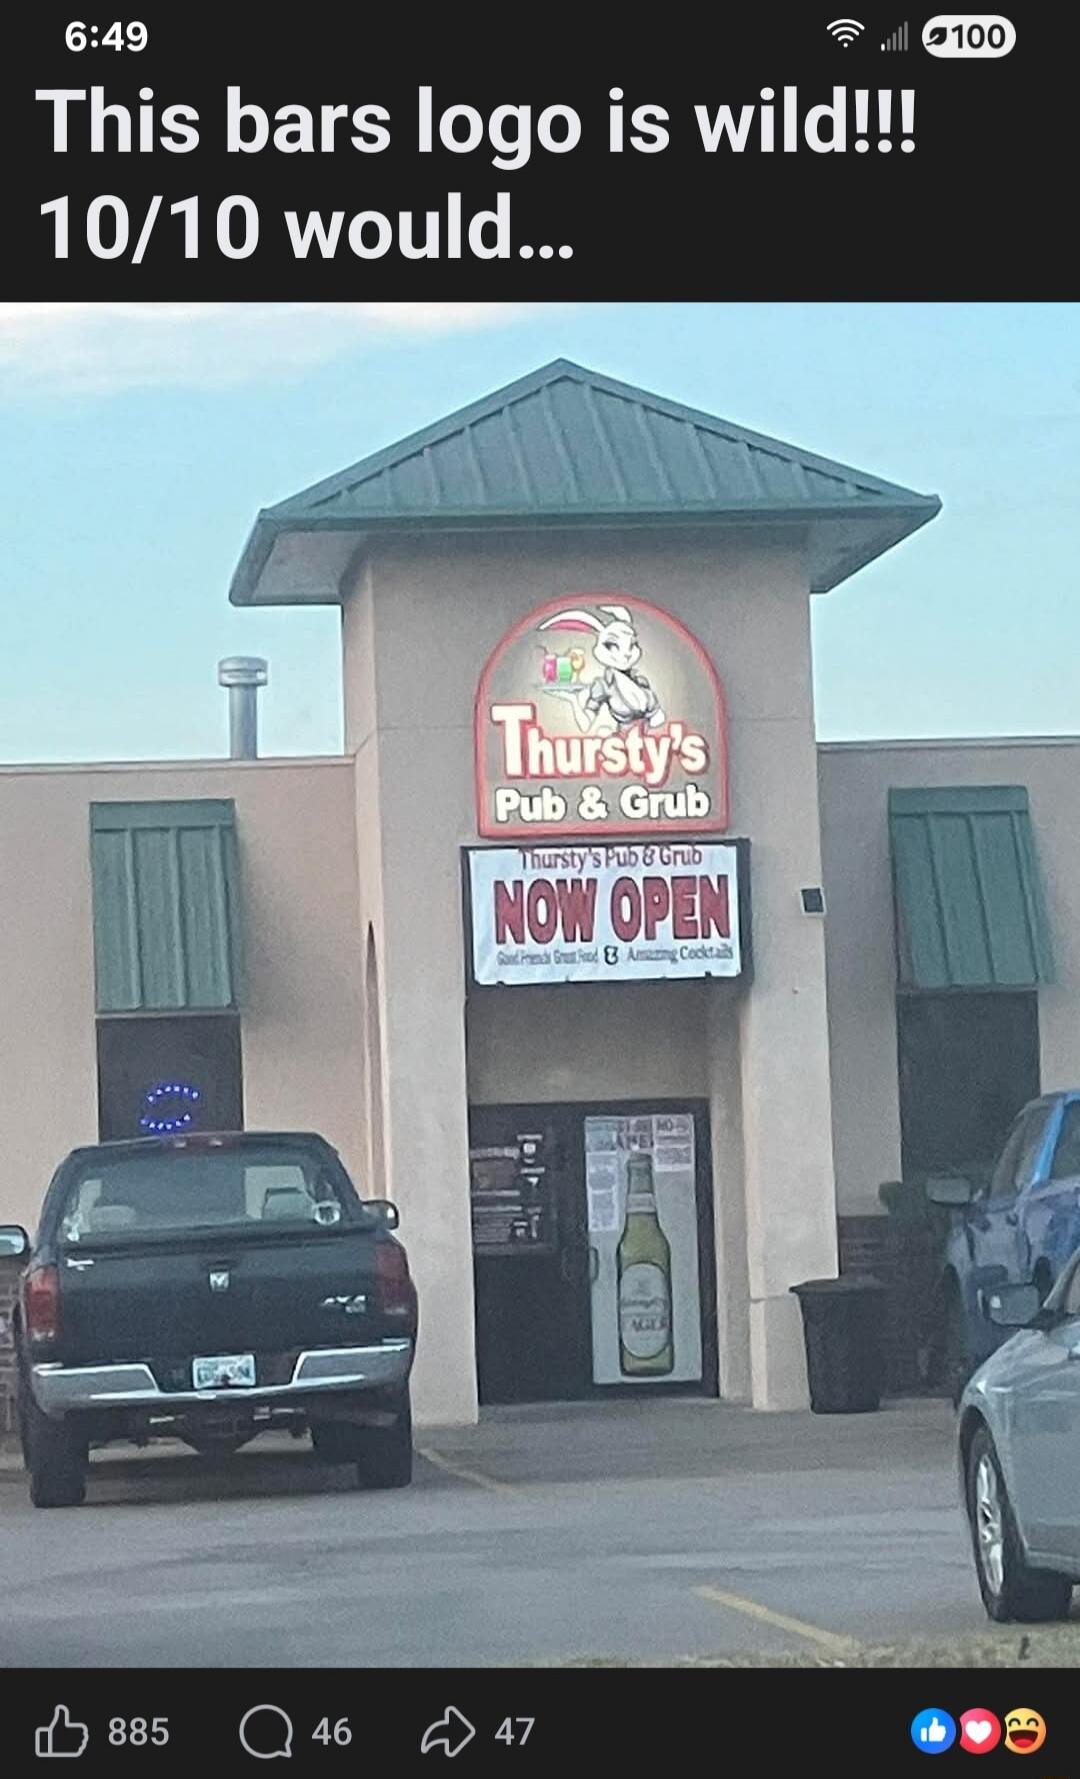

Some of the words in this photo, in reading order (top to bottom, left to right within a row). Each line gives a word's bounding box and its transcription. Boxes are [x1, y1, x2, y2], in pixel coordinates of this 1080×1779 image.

[490, 703, 709, 787] Thursty's
[494, 787, 568, 823] Pub
[577, 786, 609, 821] &
[619, 783, 711, 820] Grub
[519, 849, 602, 874] Thursty's
[604, 848, 640, 868] Pub
[642, 846, 655, 866] &
[659, 846, 703, 866] Grub
[494, 877, 598, 944] NOW
[610, 874, 731, 942] OPEN
